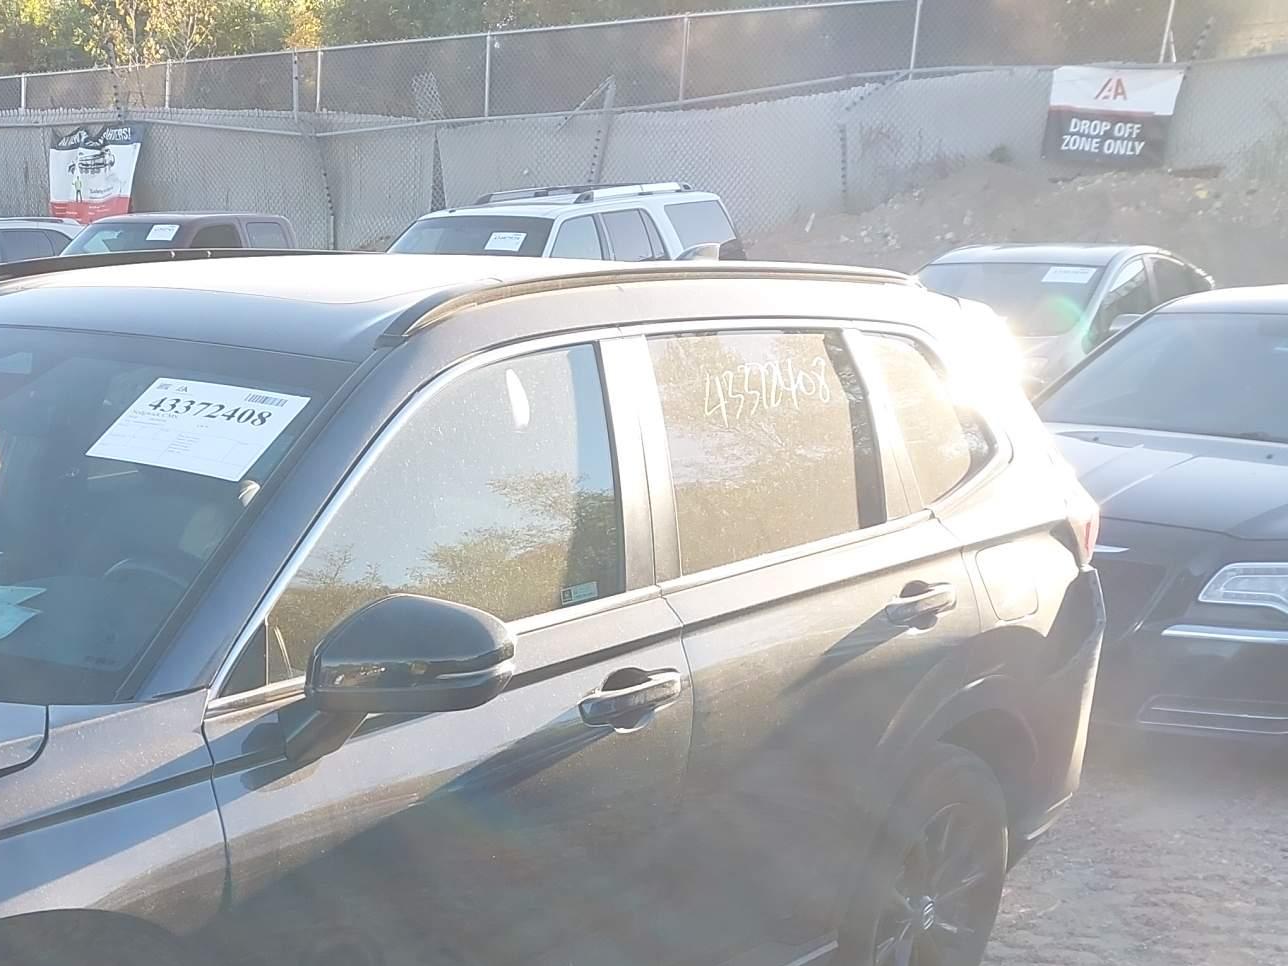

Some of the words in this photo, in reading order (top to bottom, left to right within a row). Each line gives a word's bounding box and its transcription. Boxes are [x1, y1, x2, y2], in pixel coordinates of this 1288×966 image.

[1069, 118, 1111, 136] DROP
[1114, 122, 1142, 138] OFF
[1061, 135, 1101, 153] ZONE
[1103, 139, 1145, 156] ONLY
[148, 397, 273, 427] 43372408
